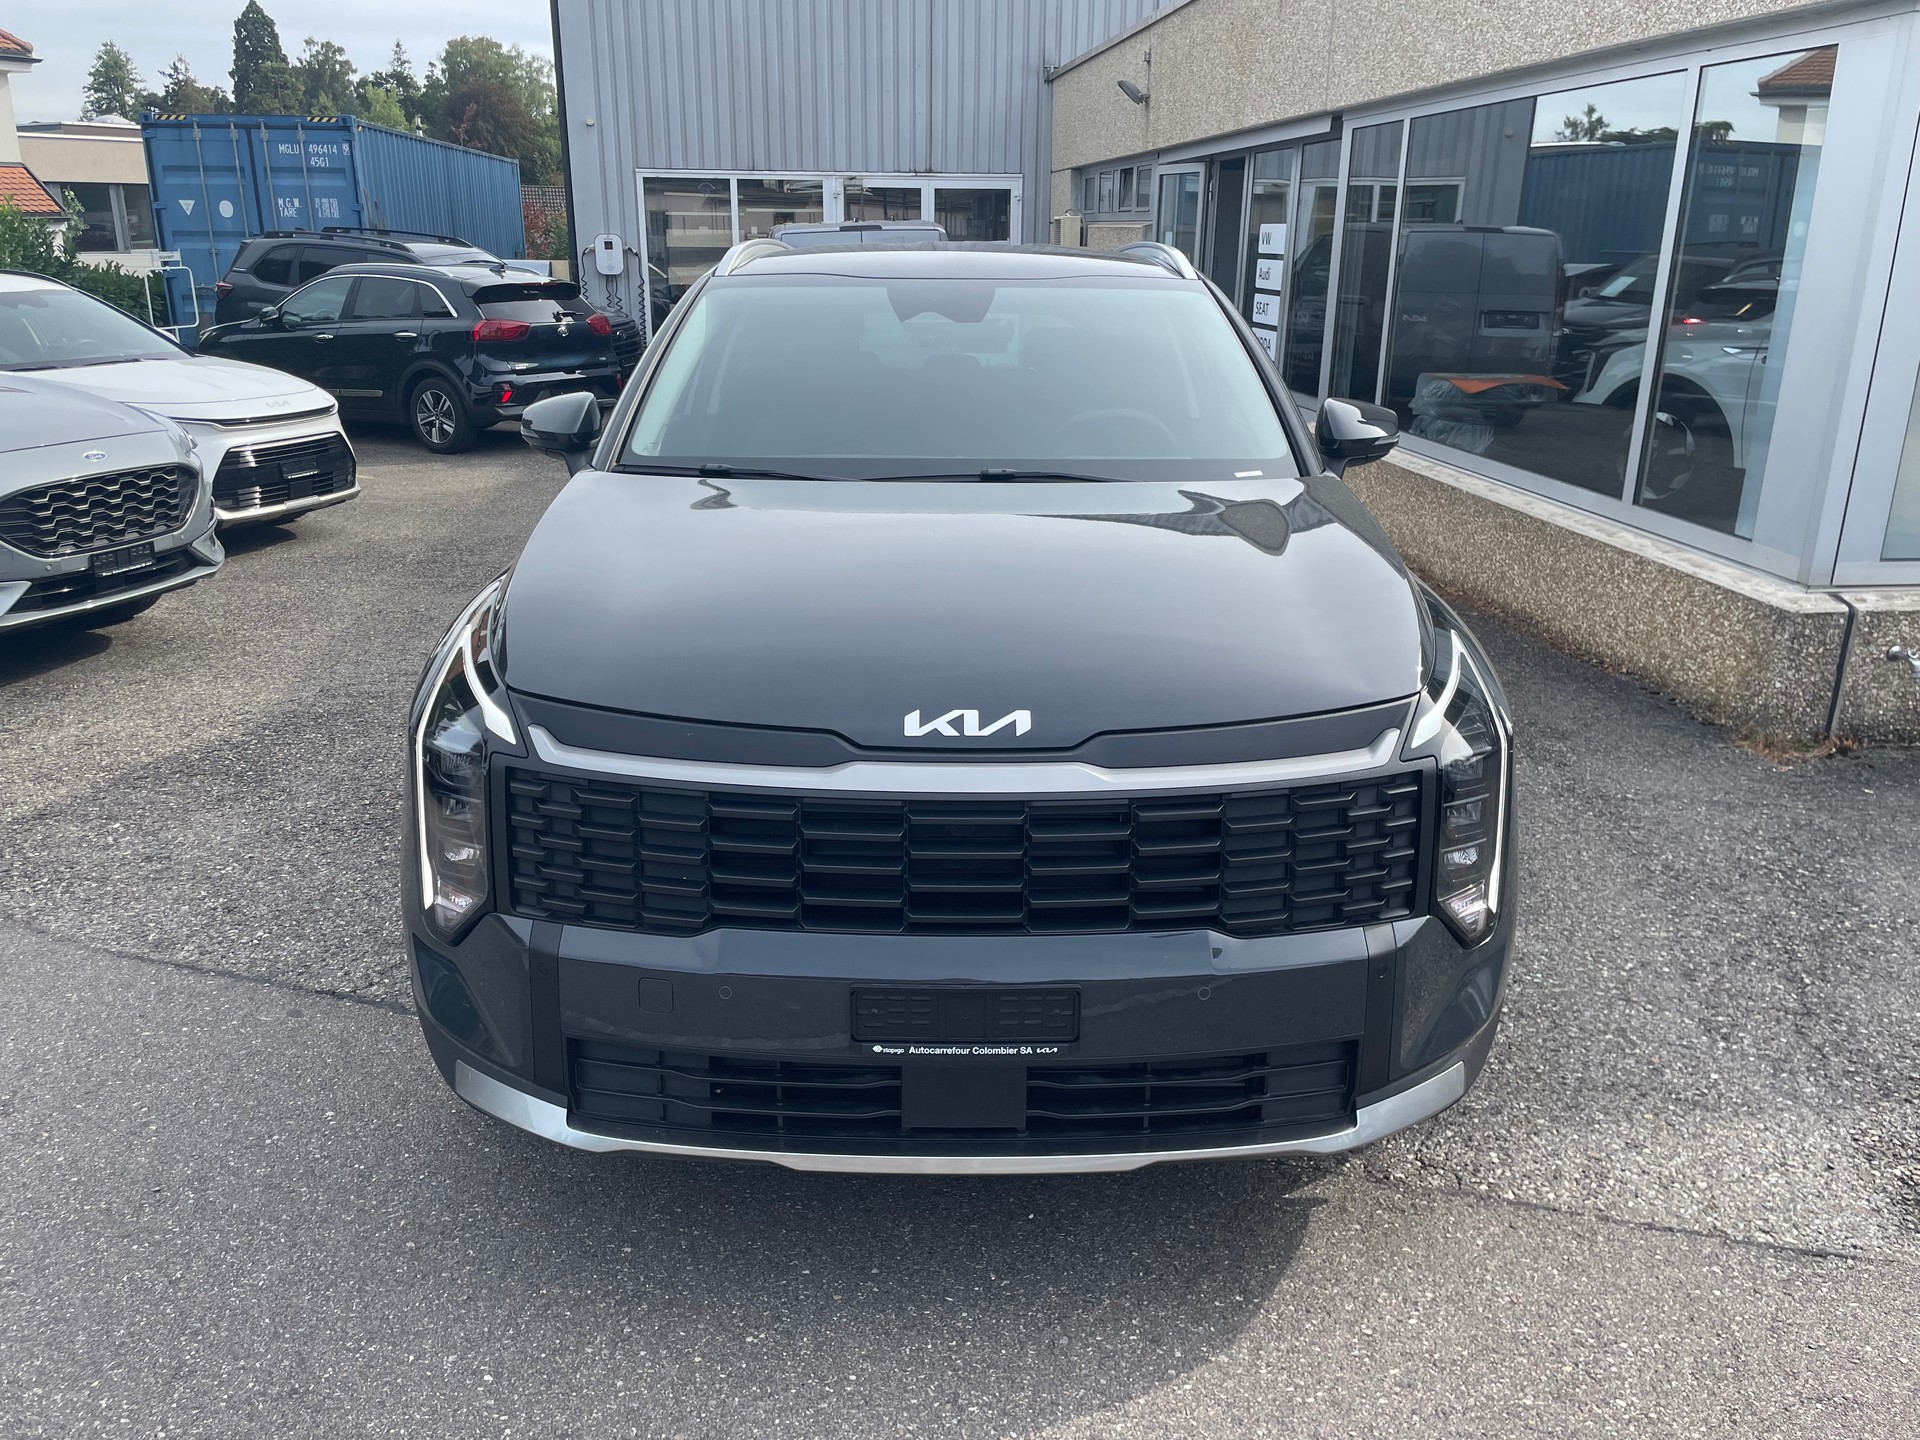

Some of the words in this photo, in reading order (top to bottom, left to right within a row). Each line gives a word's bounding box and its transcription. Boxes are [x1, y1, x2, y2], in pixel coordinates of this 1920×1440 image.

[278, 143, 300, 154] MGLU
[308, 143, 338, 155] 496414
[342, 144, 349, 154] 9
[310, 156, 329, 167] 45G1
[279, 207, 299, 218] TARE
[1261, 231, 1272, 246] VW
[1258, 267, 1271, 281] Audi
[1255, 301, 1269, 316] SEAT
[904, 709, 1031, 736] KIA
[909, 1046, 970, 1055] Autocarrefour
[972, 1046, 1018, 1055] Colombier
[1020, 1046, 1033, 1055] SA
